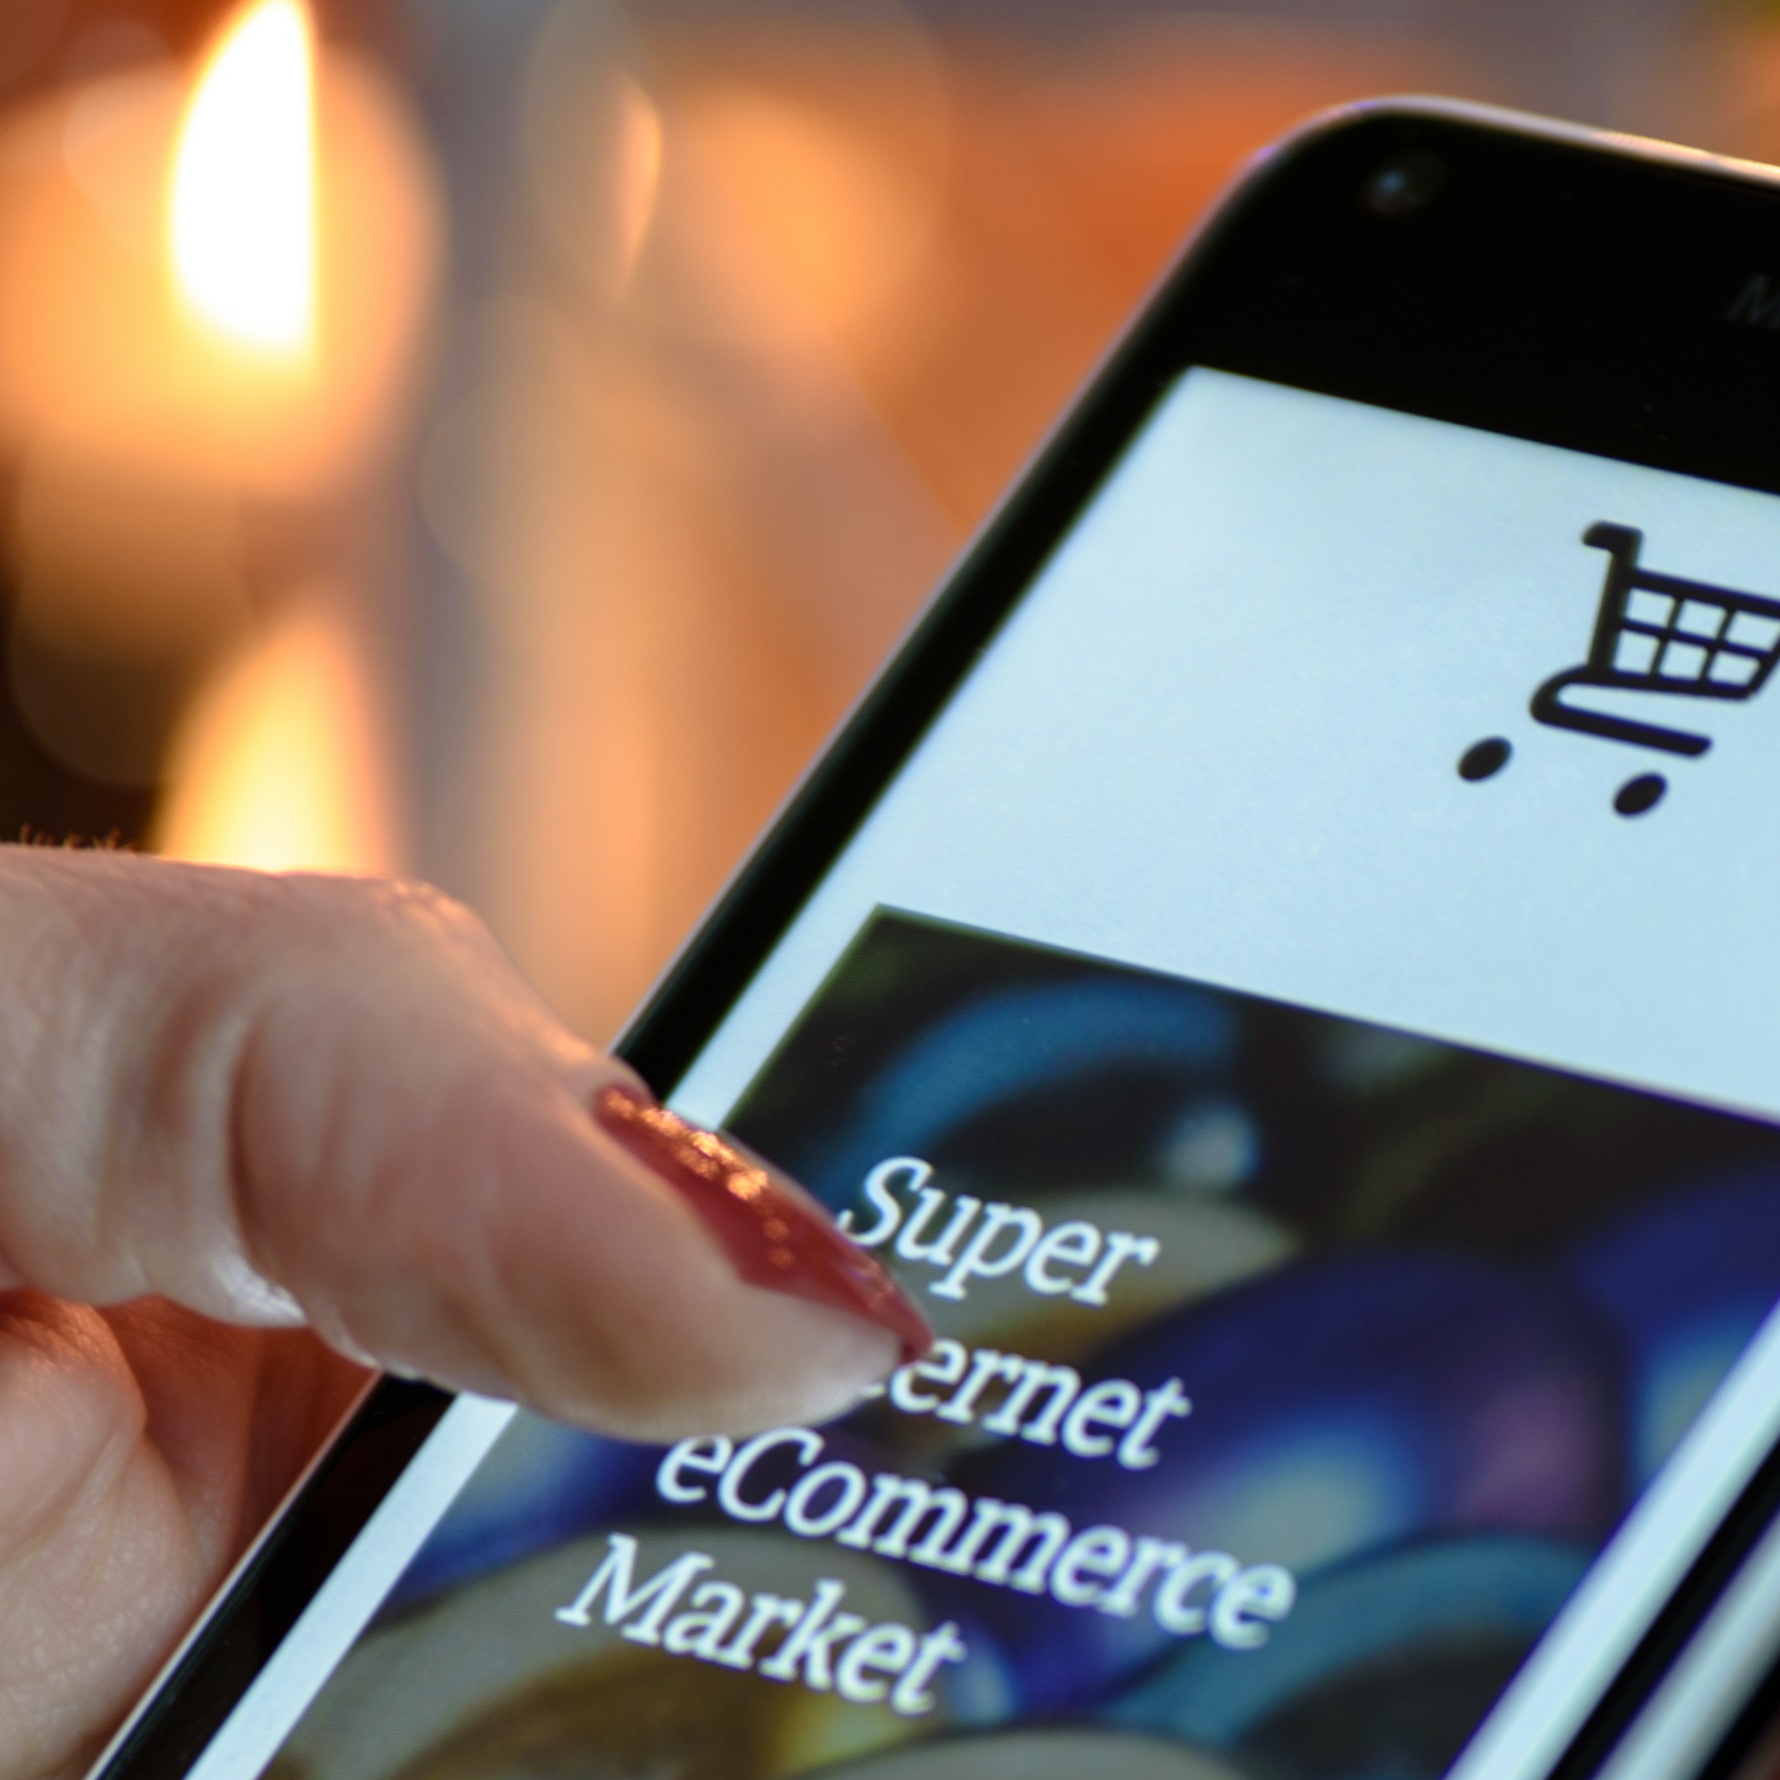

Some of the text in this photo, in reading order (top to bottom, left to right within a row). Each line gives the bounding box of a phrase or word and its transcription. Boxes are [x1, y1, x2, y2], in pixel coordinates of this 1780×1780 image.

[834, 1155, 1162, 1307] Super
[555, 1533, 967, 1716] Market
[656, 1425, 1296, 1649] eCommerce
